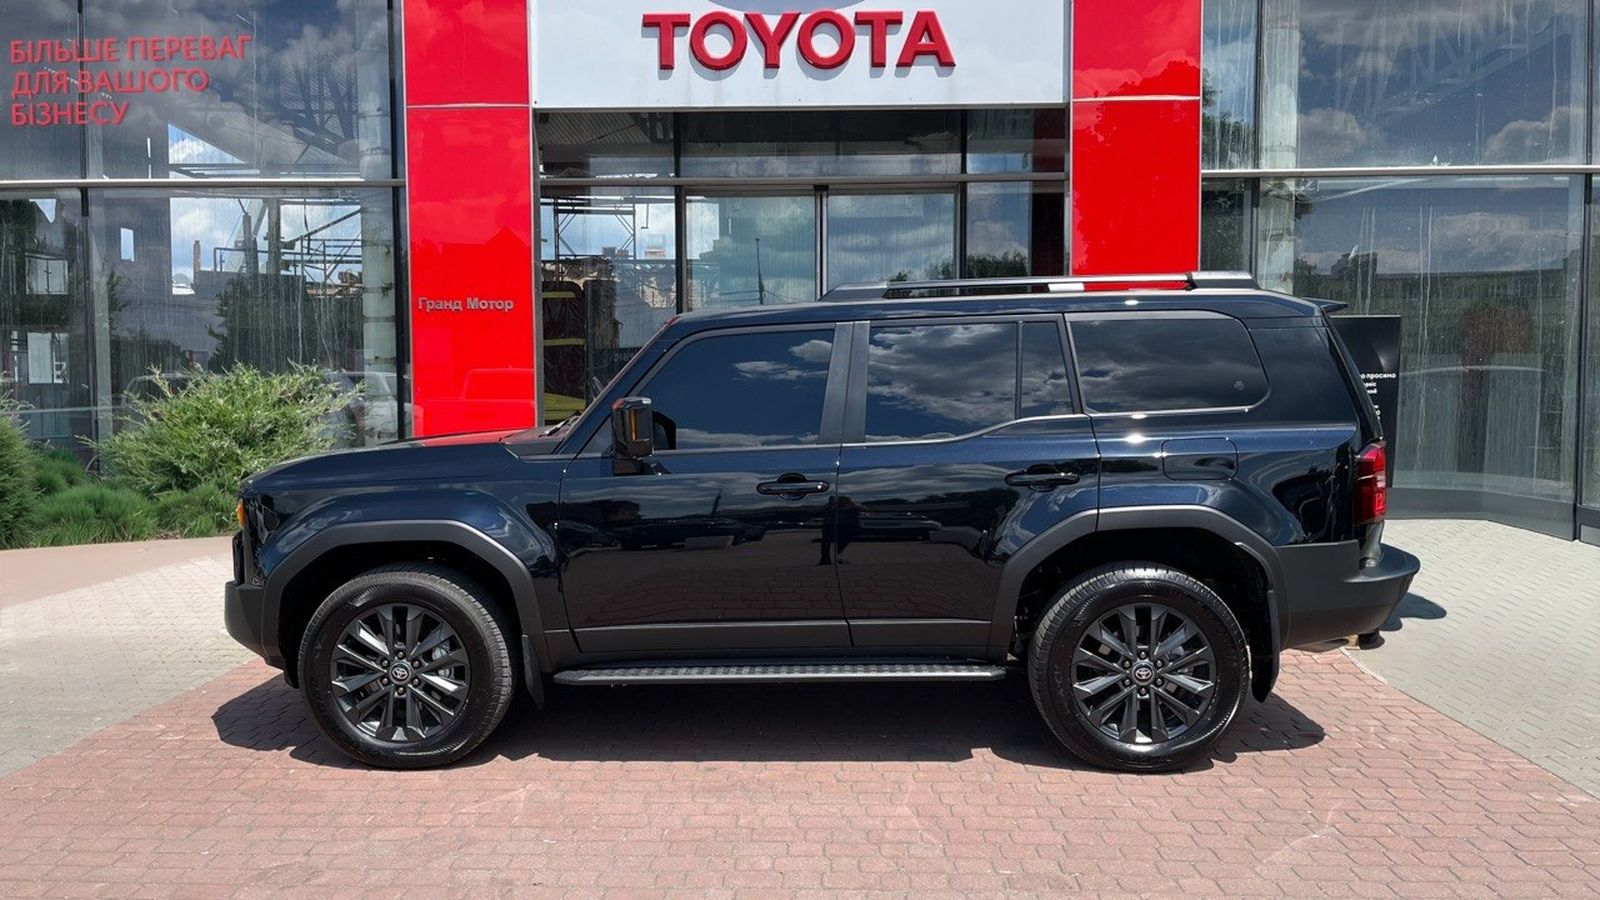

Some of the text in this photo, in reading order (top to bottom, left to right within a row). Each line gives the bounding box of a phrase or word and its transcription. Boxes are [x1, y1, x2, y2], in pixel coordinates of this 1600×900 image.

[9, 35, 253, 64] БІЛЬШЕ ПЕРЕВАГ
[642, 10, 957, 71] TOYOTA
[11, 67, 210, 99] ДЛЯ ВАШОГО
[11, 102, 129, 127] БІЗНЕСУ
[418, 297, 514, 312] Гранд Мотор
